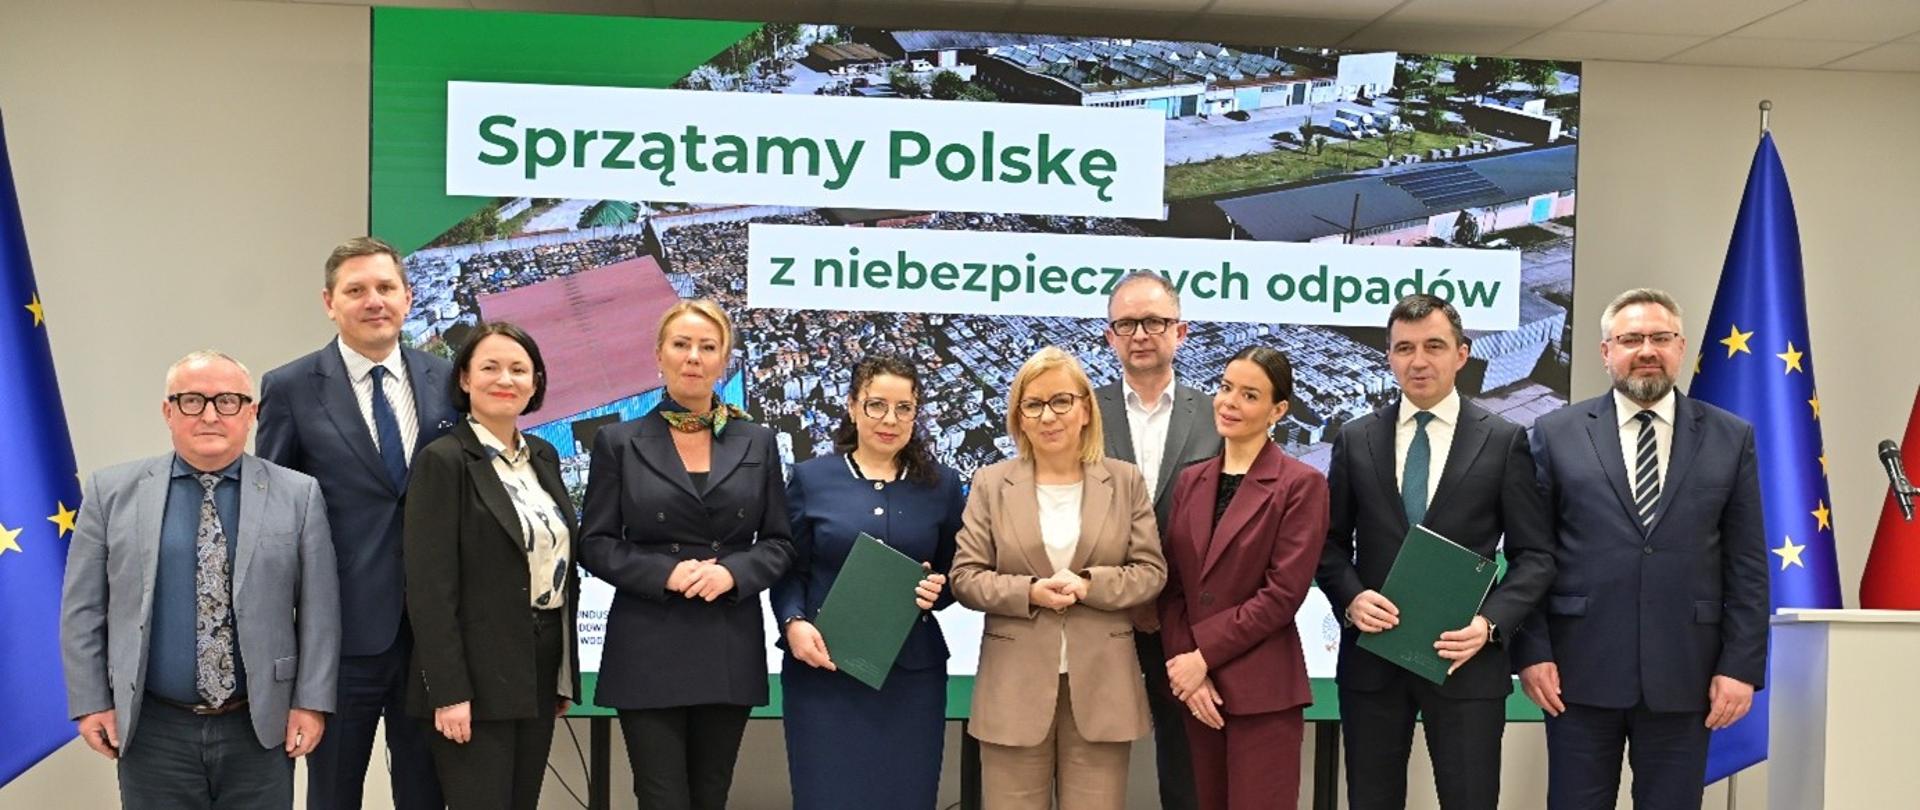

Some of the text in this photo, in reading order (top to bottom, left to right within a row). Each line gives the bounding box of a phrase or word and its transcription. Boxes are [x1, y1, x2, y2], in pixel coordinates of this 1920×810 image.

[476, 114, 1119, 203] Sprzątamy Polskę
[769, 246, 1502, 314] z niebezpieczych odpadów
